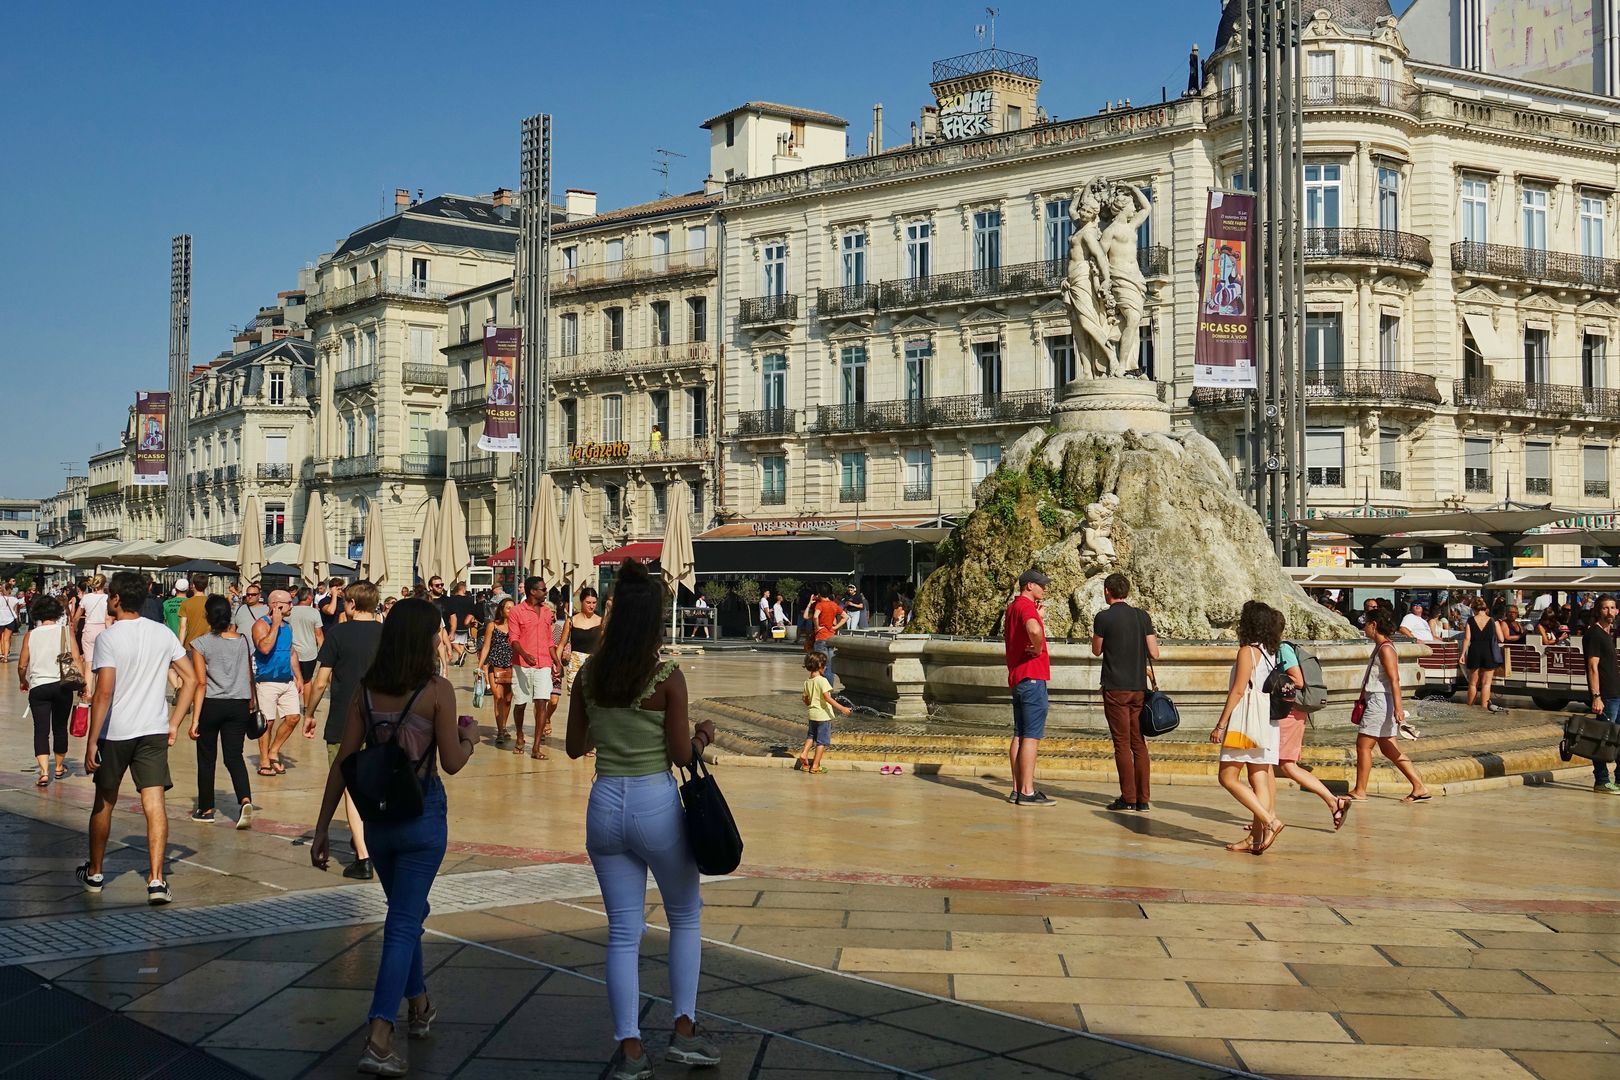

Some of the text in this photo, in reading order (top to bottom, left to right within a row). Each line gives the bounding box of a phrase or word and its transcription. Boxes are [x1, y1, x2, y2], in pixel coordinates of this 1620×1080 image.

[1200, 322, 1247, 333] PICASSO
[568, 441, 629, 460] La Gazette
[1553, 653, 1563, 663] M
